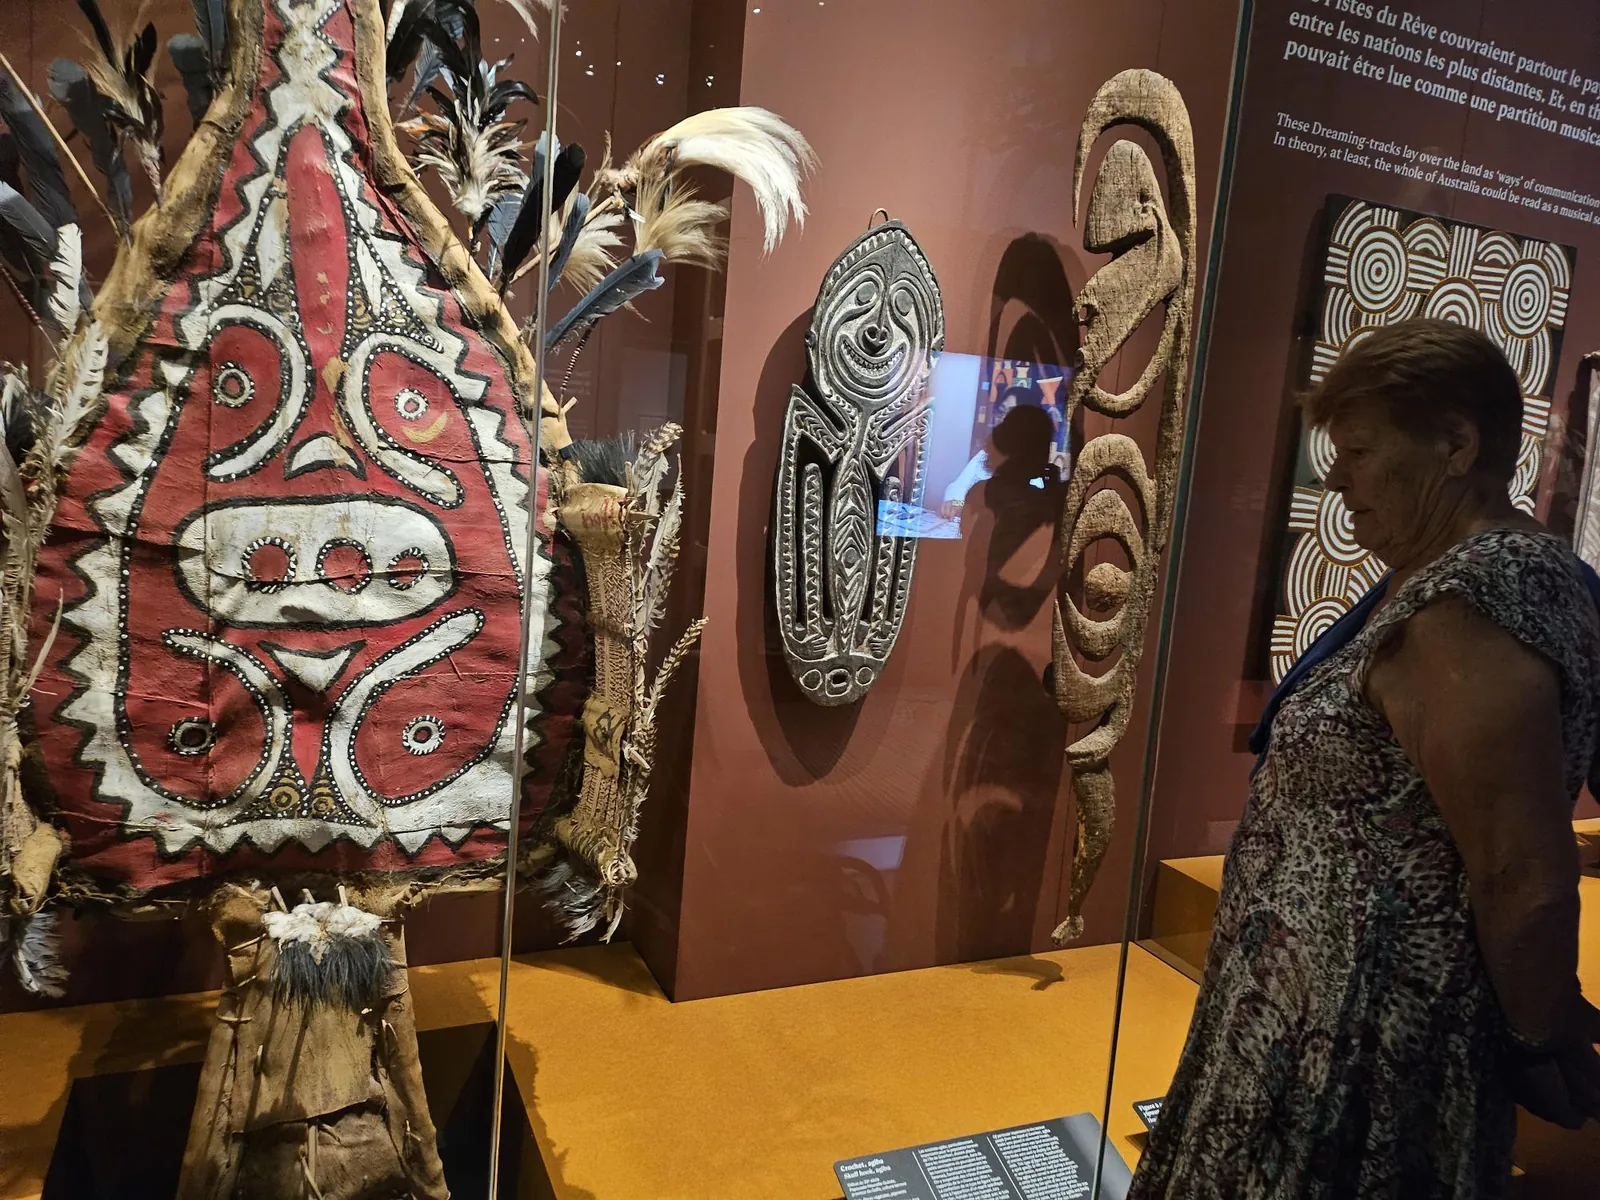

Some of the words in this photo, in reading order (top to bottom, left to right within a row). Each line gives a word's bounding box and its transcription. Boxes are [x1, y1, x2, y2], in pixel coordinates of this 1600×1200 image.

[1283, 40, 1351, 71] pouvait
[1352, 54, 1385, 80] être
[1387, 64, 1412, 88] lue
[1414, 78, 1468, 105] comme
[1470, 94, 1497, 113] une
[1496, 103, 1558, 133] partition
[1289, 11, 1334, 36] entre
[1336, 21, 1360, 44] les
[1363, 34, 1423, 63] nations
[1424, 48, 1446, 70] les
[1446, 58, 1479, 81] plus
[1481, 67, 1546, 103] distantes.
[1548, 88, 1566, 112] Et,
[1569, 100, 1586, 116] en
[1377, 5, 1398, 26] du
[1400, 12, 1437, 39] Rêve
[1439, 30, 1516, 65] couvraient
[1515, 55, 1568, 83] partout
[1569, 69, 1582, 87] le
[1273, 131, 1286, 146] In
[1288, 135, 1328, 158] theory,
[1330, 148, 1343, 159] at
[1343, 148, 1372, 168] least,
[1374, 157, 1392, 172] the
[1394, 163, 1424, 179] whole
[1425, 170, 1438, 183] of
[1436, 172, 1480, 195] Australia
[1481, 187, 1508, 201] could
[1508, 191, 1520, 204] be
[1521, 197, 1542, 210] read
[1541, 201, 1552, 212] as
[1552, 204, 1559, 214] a
[1560, 206, 1594, 222] musical
[1277, 112, 1310, 132] These
[1311, 121, 1402, 156] Dreaming-tracks
[1402, 145, 1419, 163] lay
[1420, 152, 1442, 166] over
[1443, 156, 1460, 171] the
[1461, 160, 1483, 177] land
[1483, 168, 1495, 180] as
[1524, 178, 1537, 190] of
[1535, 183, 1600, 208] communication
